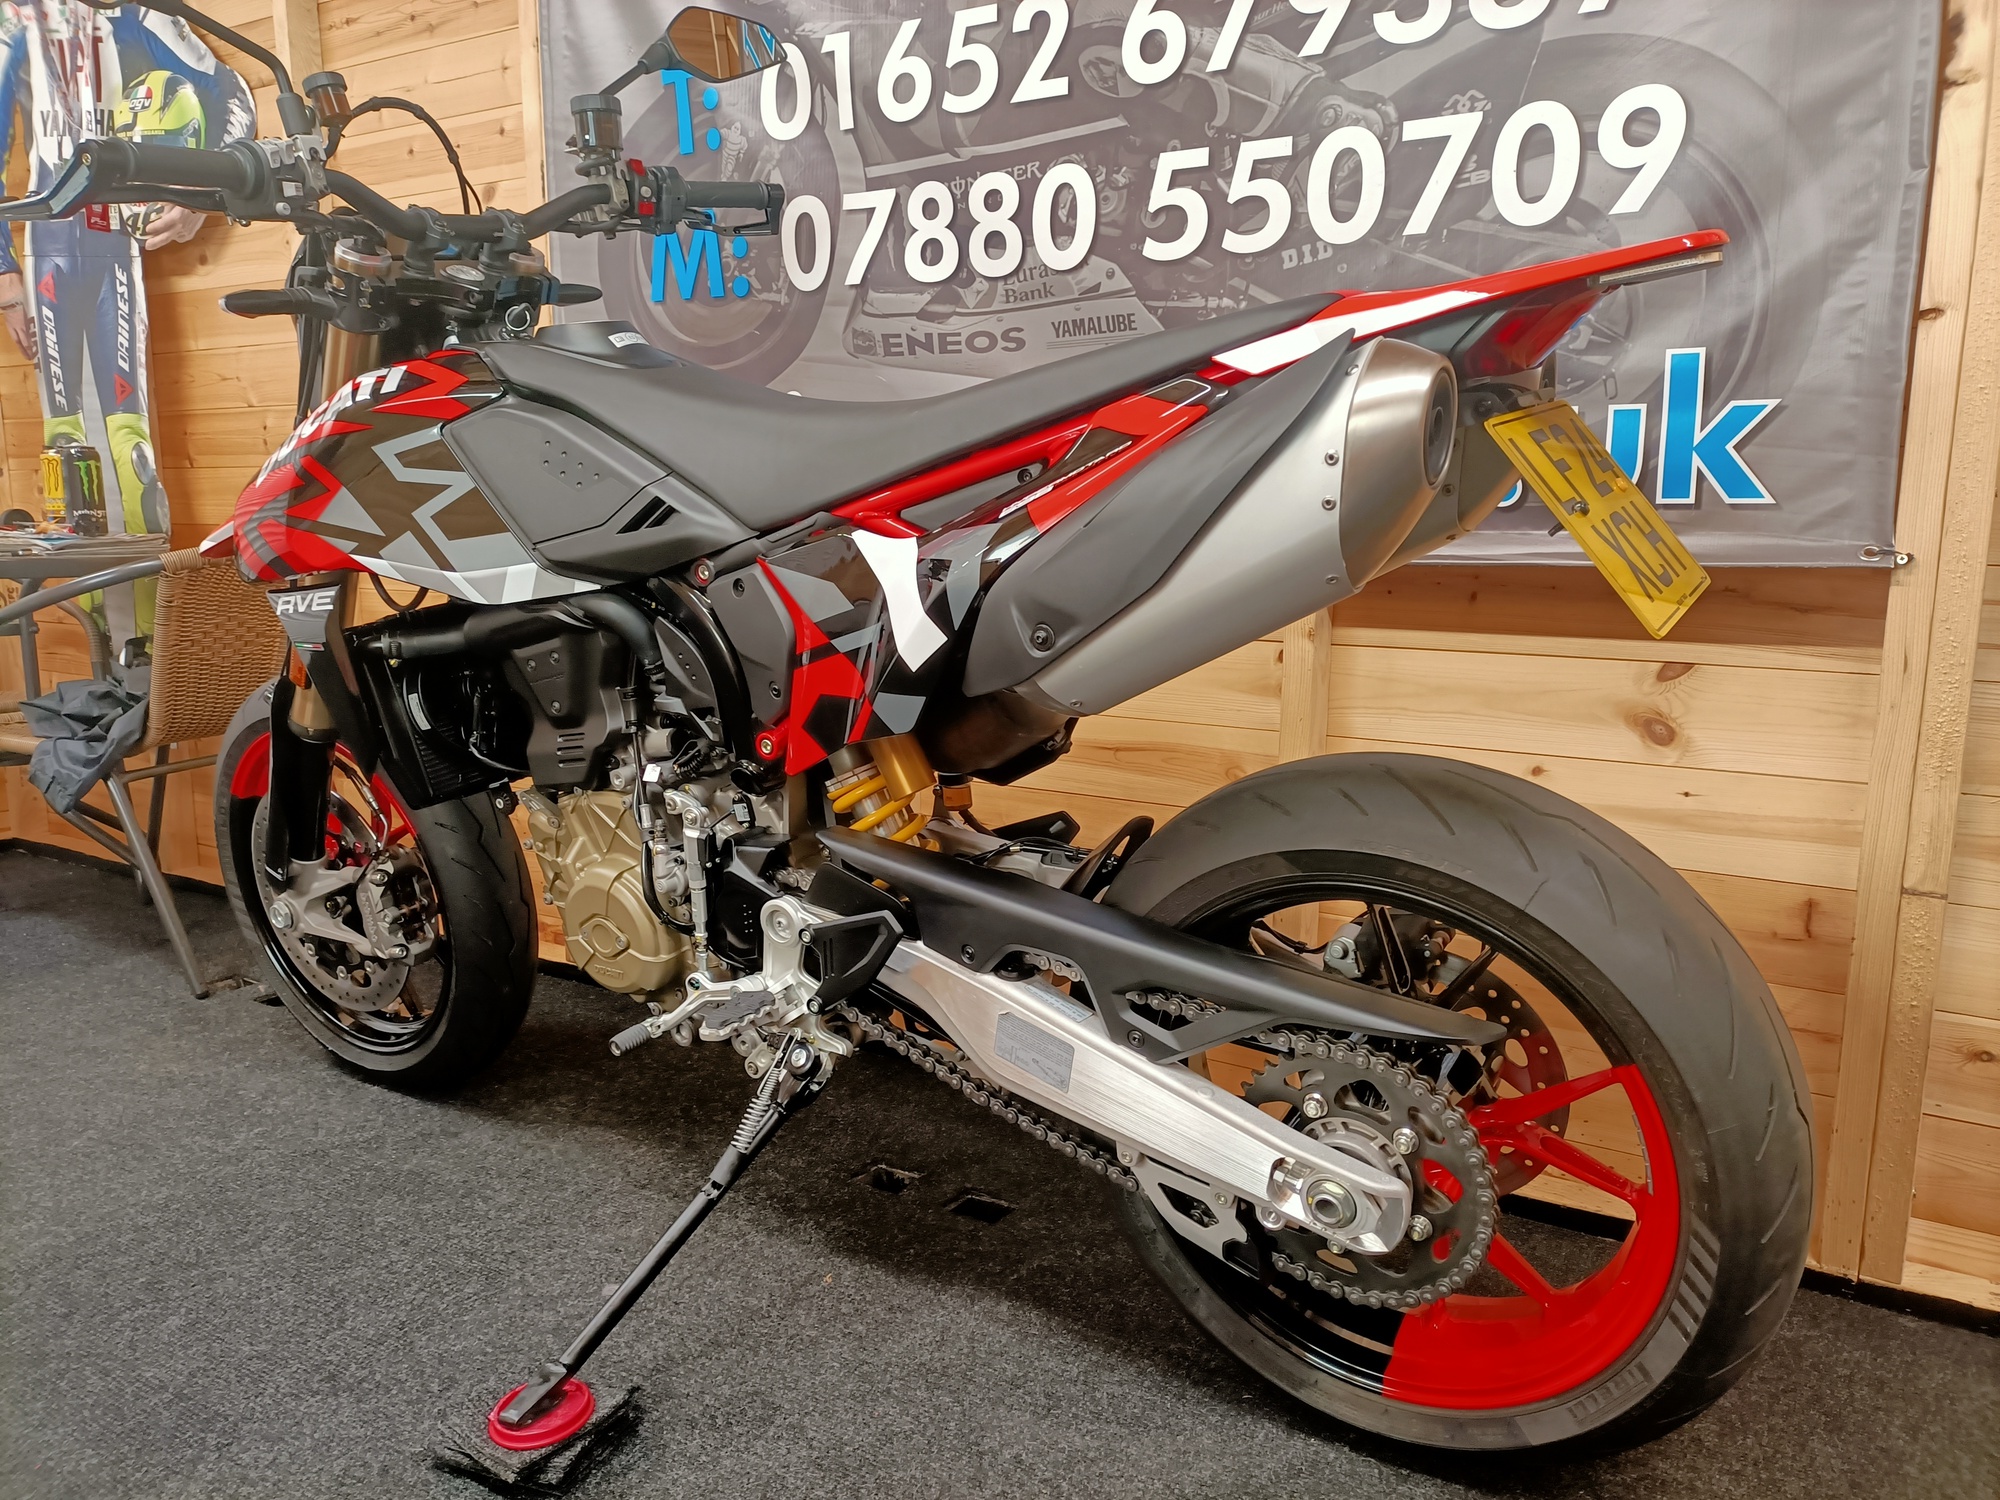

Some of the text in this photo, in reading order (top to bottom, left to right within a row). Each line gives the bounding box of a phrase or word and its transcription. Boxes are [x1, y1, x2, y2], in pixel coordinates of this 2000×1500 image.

[760, 0, 1070, 141] 01652
[781, 163, 1098, 292] 07880
[1141, 83, 1687, 262] 550709
[1004, 281, 1056, 304] Bank
[880, 326, 1027, 358] ENEOS
[1050, 312, 1138, 339] YAMALUBE
[1507, 418, 1624, 517] LF24
[1590, 500, 1688, 603] XCH
[276, 591, 336, 616] RVE
